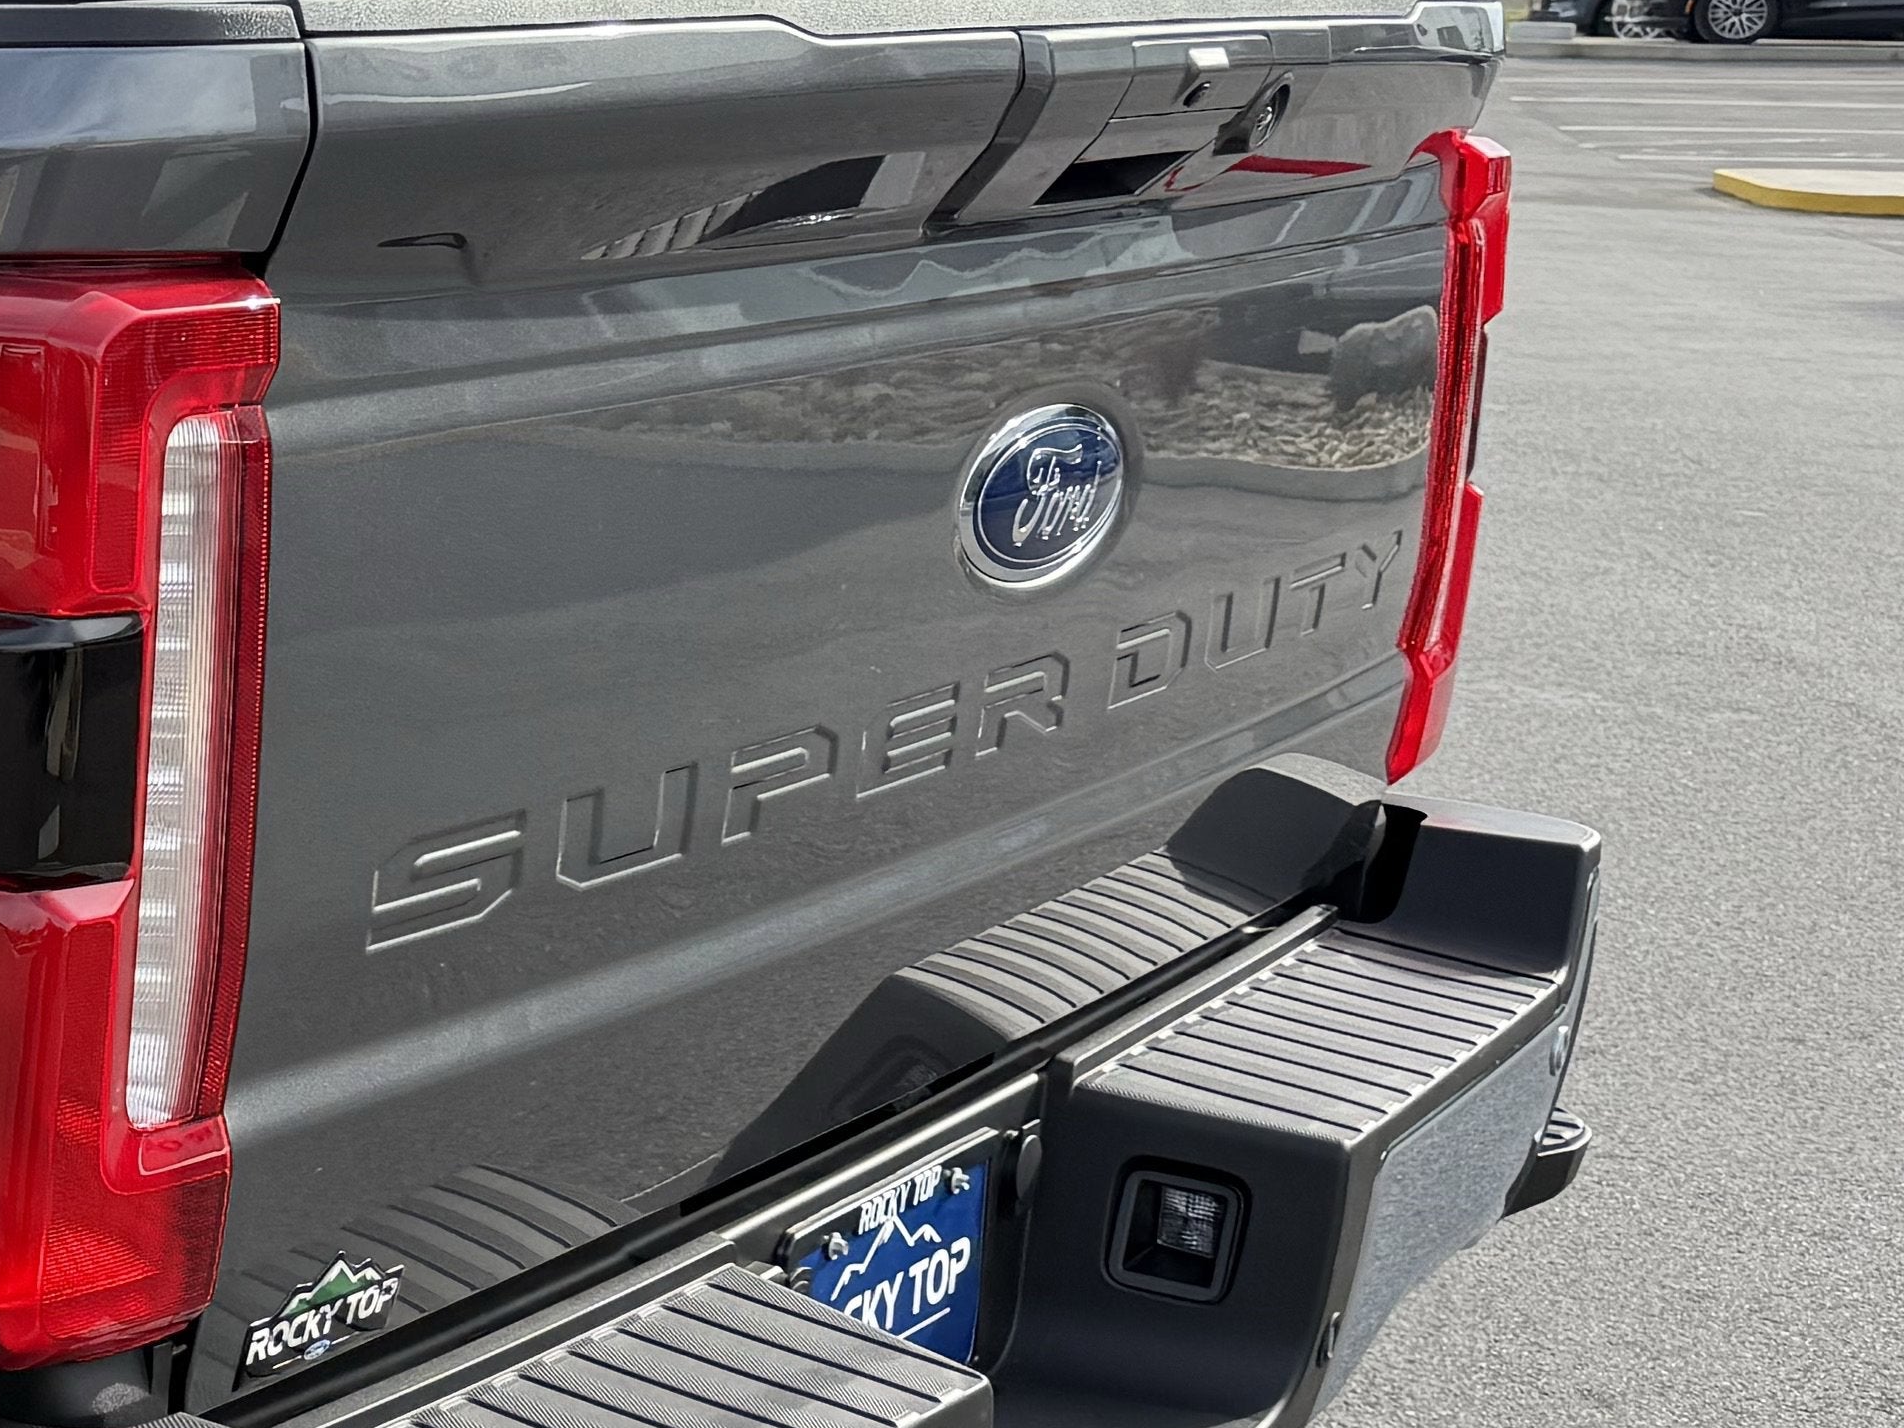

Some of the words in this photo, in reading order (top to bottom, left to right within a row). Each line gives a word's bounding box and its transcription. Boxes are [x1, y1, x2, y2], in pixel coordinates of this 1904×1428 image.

[1011, 442, 1103, 548] Ford
[365, 650, 1071, 954] SUPER
[1106, 529, 1405, 710] DUTY
[857, 1180, 912, 1236] ROCKY
[912, 1164, 943, 1207] TOP
[908, 1236, 971, 1315] TOP
[245, 1298, 344, 1366] ROCKY
[345, 1277, 399, 1325] TOP
